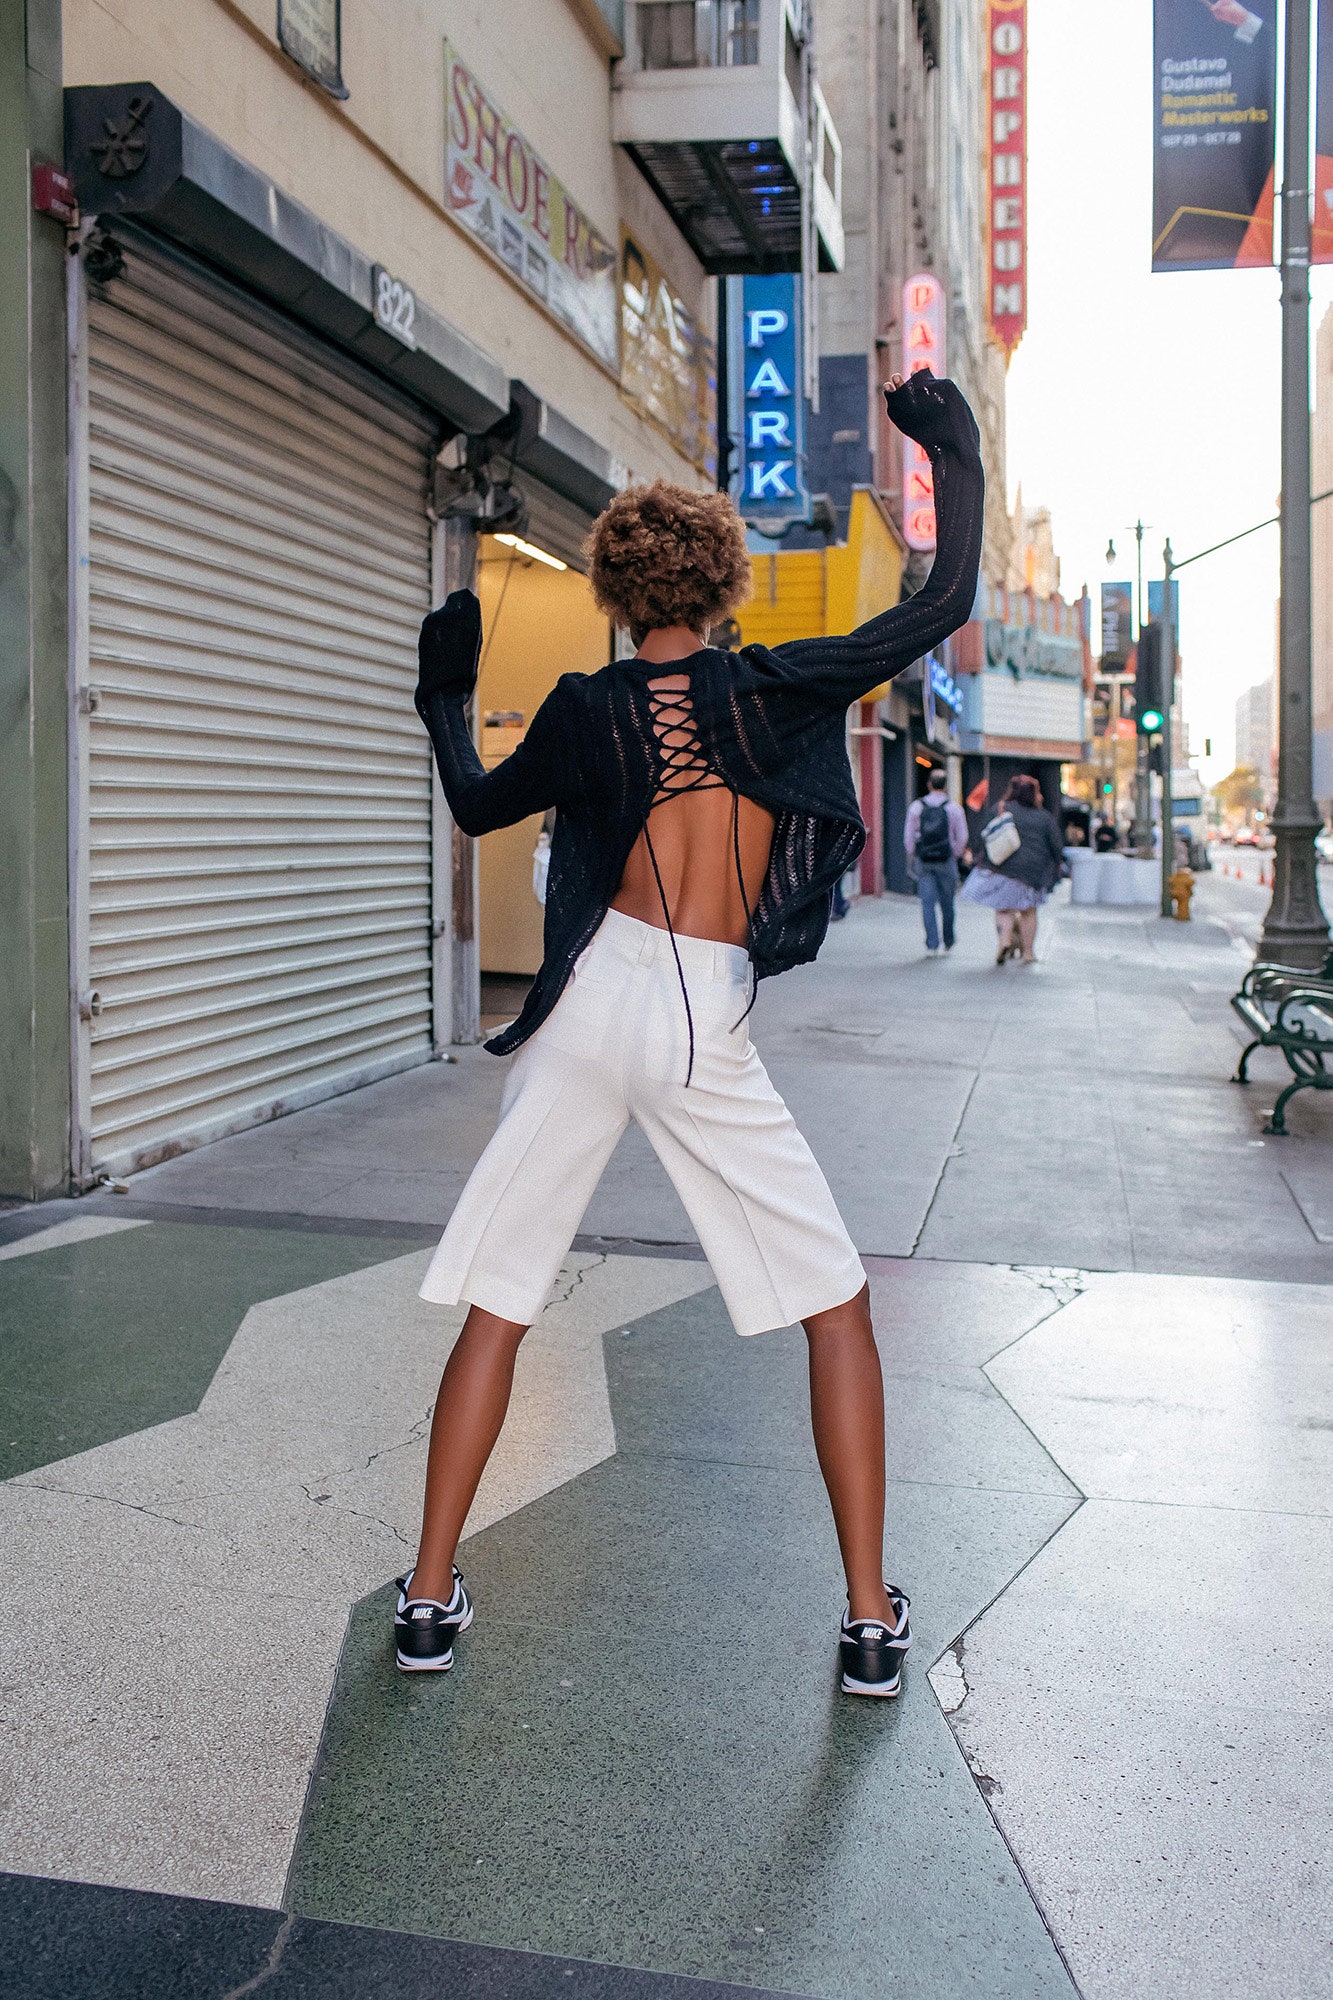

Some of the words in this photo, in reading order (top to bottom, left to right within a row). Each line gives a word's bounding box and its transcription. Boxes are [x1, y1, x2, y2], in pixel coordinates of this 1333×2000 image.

[1161, 58, 1227, 74] Gustavo
[1161, 72, 1231, 92] Dudamel
[1161, 92, 1237, 108] Romantic
[1162, 107, 1268, 126] Masterworks
[451, 65, 549, 242] SHOE
[993, 21, 1022, 315] ORPHEUM
[378, 271, 415, 342] 822
[747, 309, 795, 499] PARK
[411, 1607, 433, 1619] NIKE
[861, 1627, 884, 1640] NIKE
